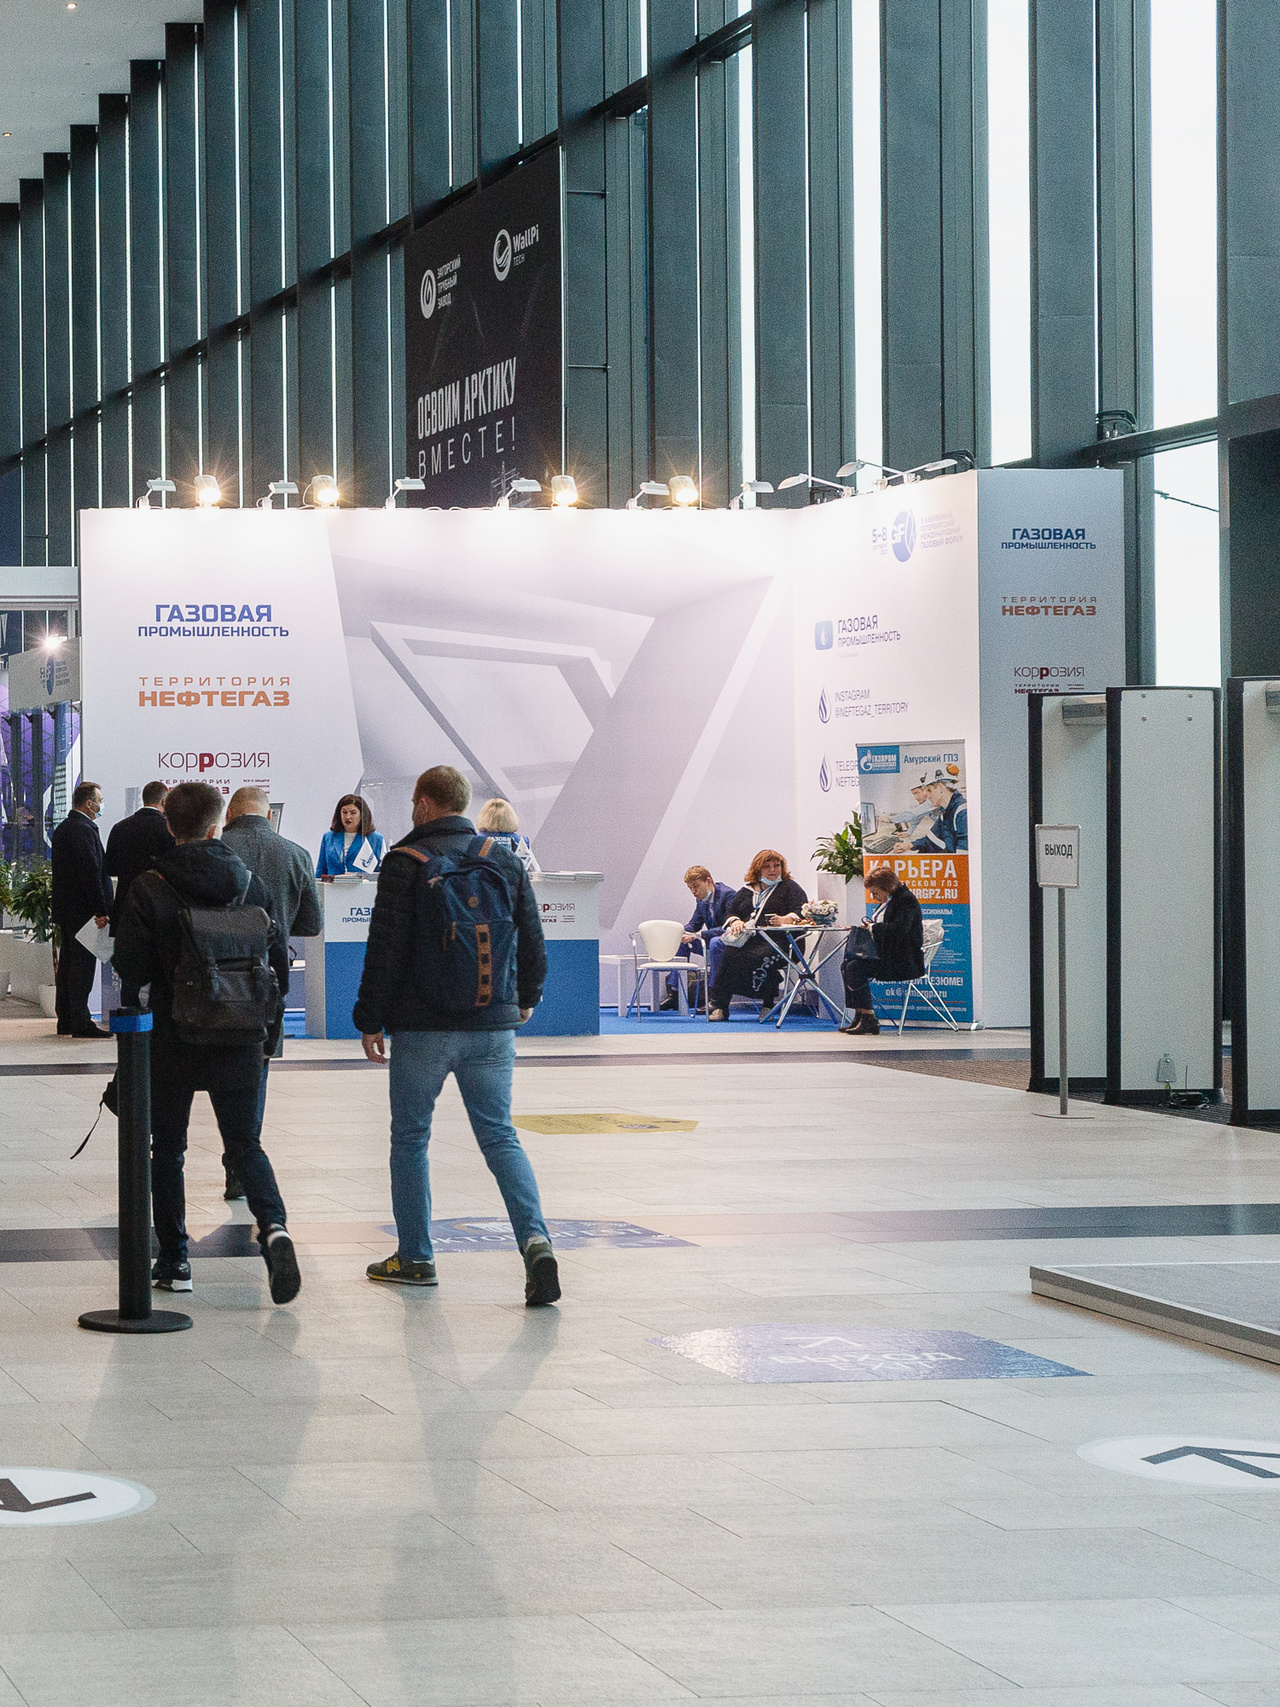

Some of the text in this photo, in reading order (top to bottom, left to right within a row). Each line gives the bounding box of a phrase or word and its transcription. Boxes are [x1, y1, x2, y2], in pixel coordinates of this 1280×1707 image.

[512, 223, 539, 253] WallPi
[417, 356, 517, 440] ОСВОИМ АРКТИКУ
[419, 416, 516, 480] ВМЕСТЕ!
[1011, 528, 1086, 540] ГАЗОВАЯ
[1001, 542, 1097, 550] ПРОМЫШЛЕННОСТЬ
[155, 604, 272, 622] ГАЗОВАЯ
[1001, 605, 1097, 616] НЕФТЕГАЗ
[138, 626, 289, 637] ПРОМЫШЛЕННОСТЬ
[837, 614, 879, 634] ГАЗОВАЯ
[837, 630, 901, 647] ПРОМЫШЛЕННОСТЬ
[139, 676, 291, 687] ТЕРРИТОРИЯ
[138, 691, 291, 707] НЕФТЕГАЗ
[835, 688, 870, 703] INSTAGRAM
[835, 702, 910, 719] @NEFTEGAZ_TERRITORY
[903, 753, 959, 765] Амурский ГПЗ
[1044, 843, 1073, 859] ВЫХОД
[941, 879, 959, 887] ГПЗ
[767, 1351, 966, 1365] ВЫХОД
[828, 1358, 936, 1371] EXIT
